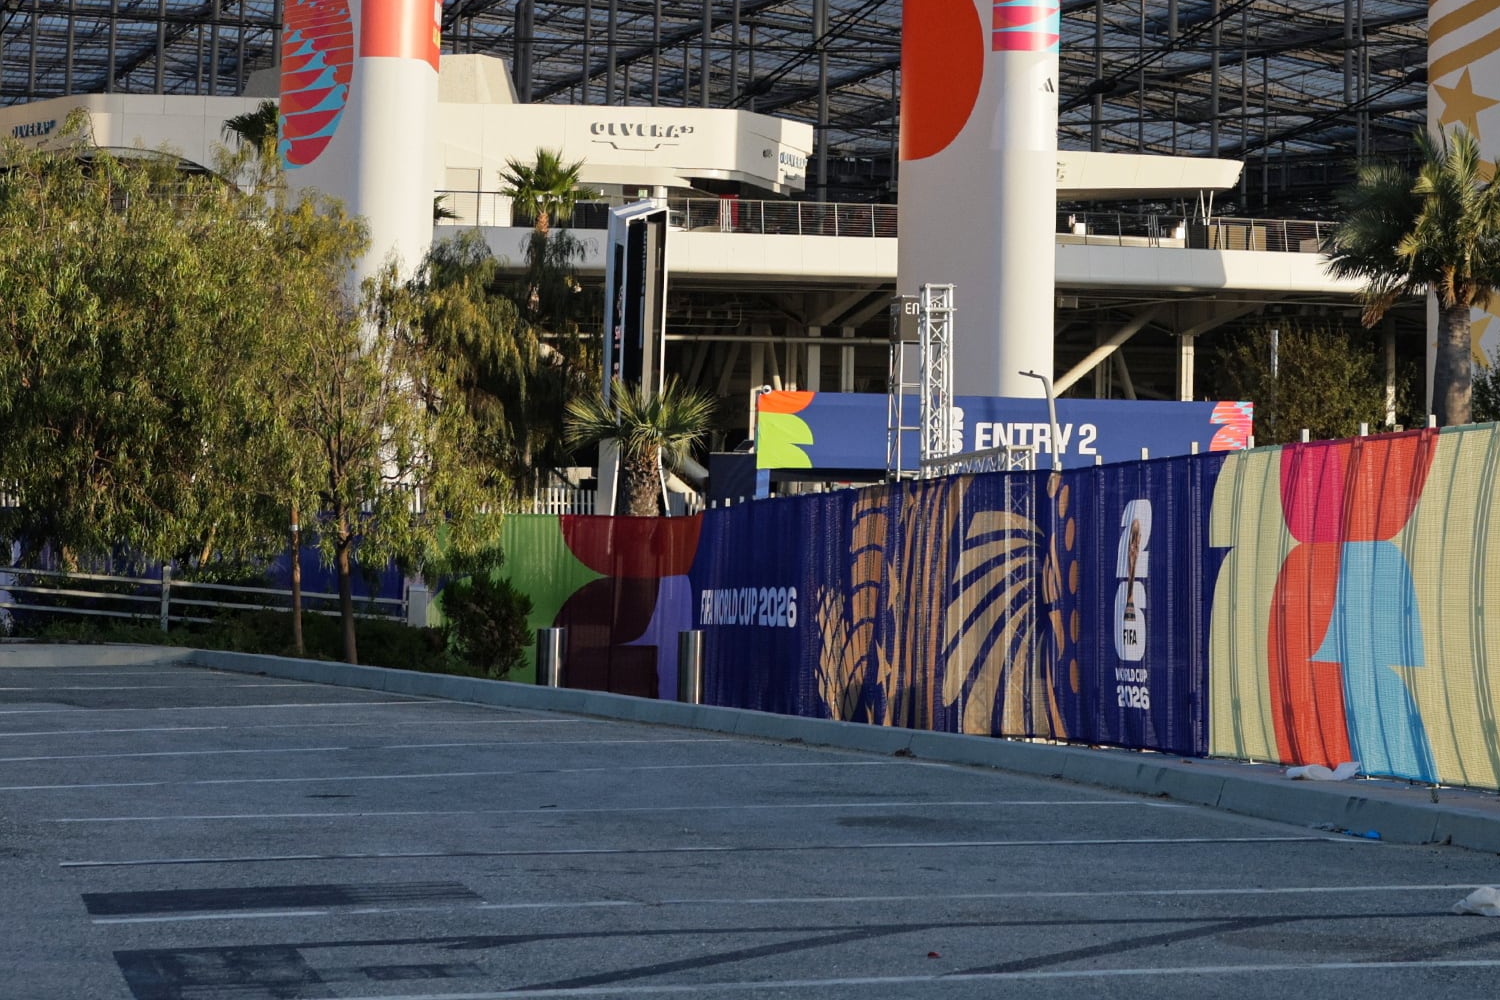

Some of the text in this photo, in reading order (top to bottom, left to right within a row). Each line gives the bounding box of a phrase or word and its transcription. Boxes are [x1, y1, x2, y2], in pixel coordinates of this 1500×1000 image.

[975, 422, 1073, 454] ENTRY
[1078, 423, 1097, 455] 2
[714, 588, 738, 625] WORLD
[739, 587, 758, 626] CUP
[758, 586, 798, 628] 2026
[1123, 629, 1137, 645] FIFA
[1115, 668, 1148, 683] WORLD CUP
[1116, 686, 1150, 710] 2026
